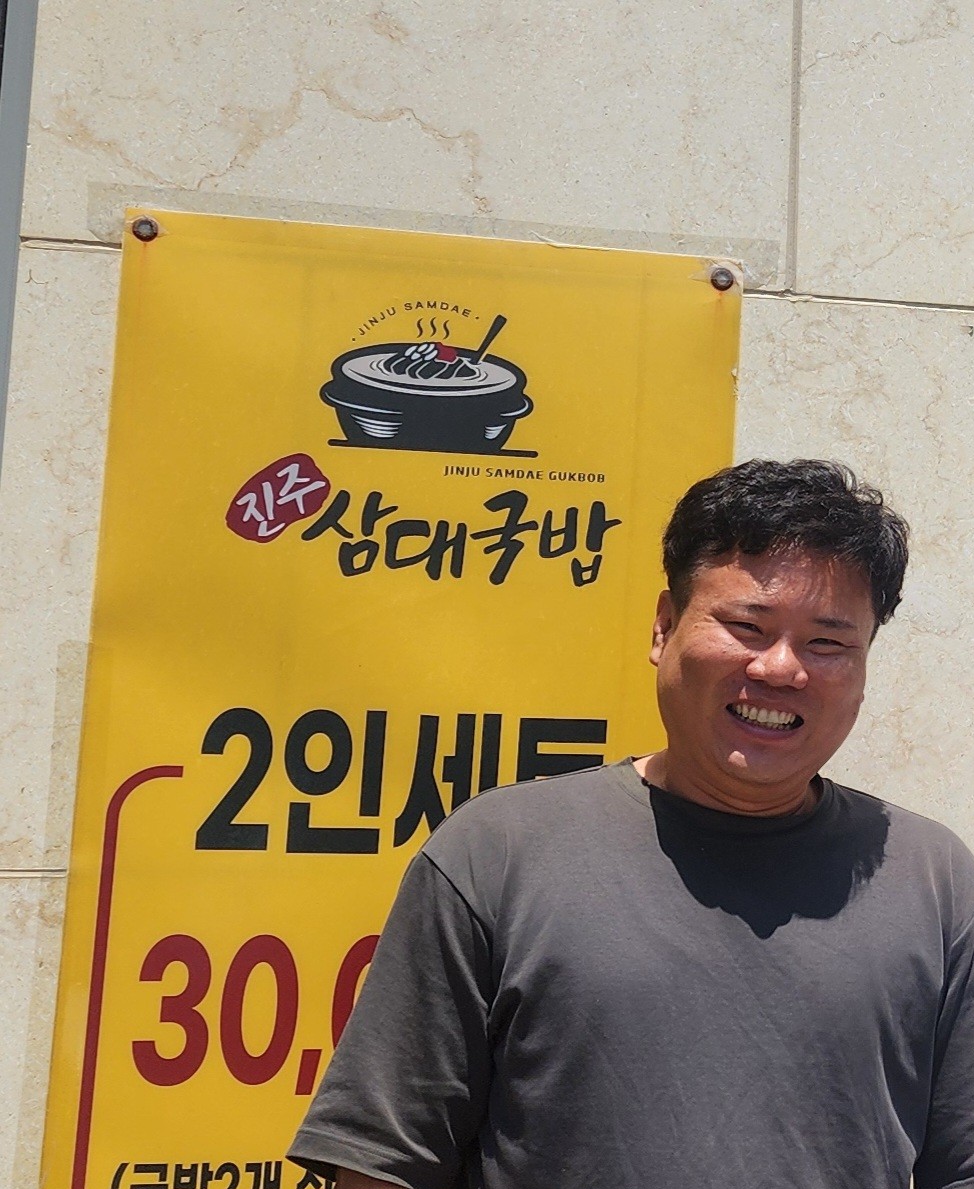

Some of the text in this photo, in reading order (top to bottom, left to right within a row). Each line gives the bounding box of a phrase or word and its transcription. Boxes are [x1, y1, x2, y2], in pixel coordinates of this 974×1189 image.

[357, 300, 472, 336] JINJU SAMDAE
[443, 465, 606, 484] JINJU SAMDAE GUKBOB
[235, 462, 623, 588] 진주 삼대국밥
